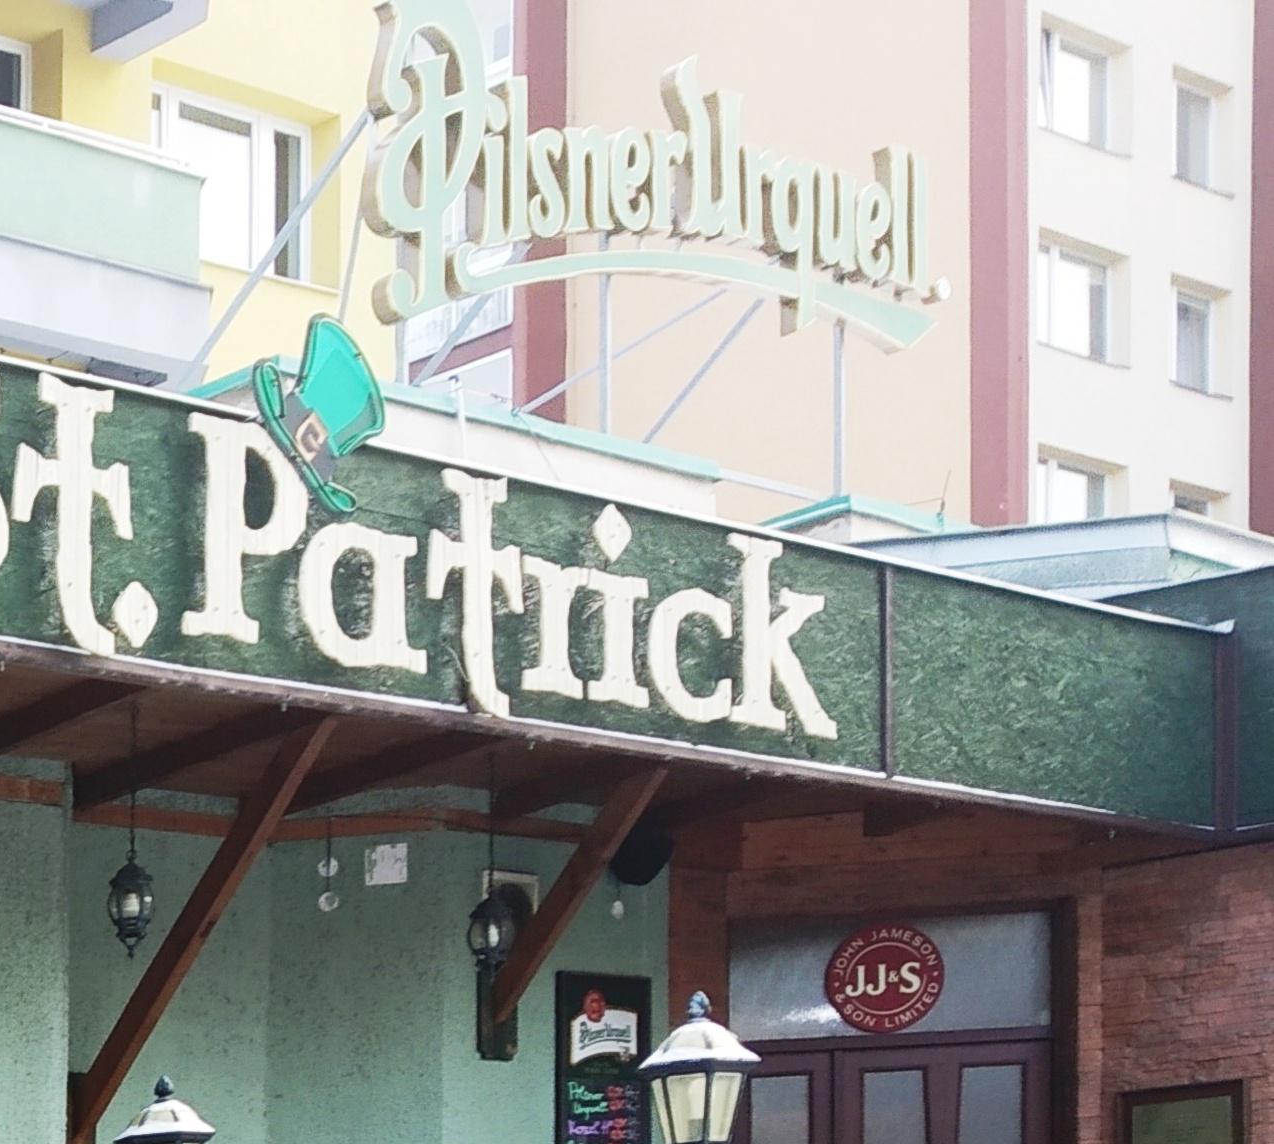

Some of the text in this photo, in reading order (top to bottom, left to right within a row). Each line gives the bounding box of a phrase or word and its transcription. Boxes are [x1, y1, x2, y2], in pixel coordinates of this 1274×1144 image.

[364, 0, 931, 337] Pilsner Urquell
[181, 411, 838, 741] Patrick
[833, 928, 939, 977] JOHN JAMESON
[844, 961, 921, 997] JJ&S
[843, 1003, 877, 1028] SON
[884, 981, 940, 1028] LIMITED
